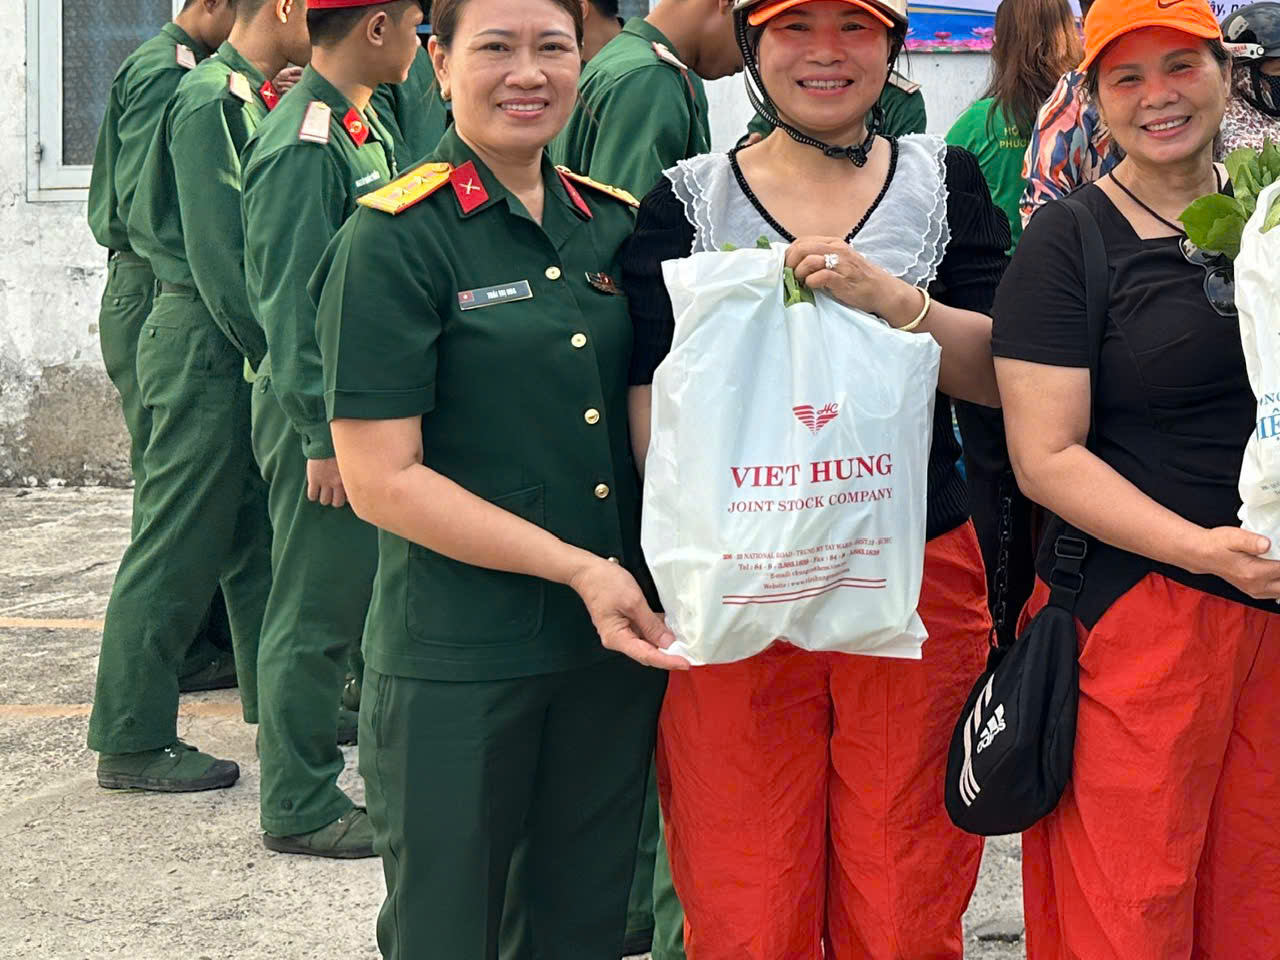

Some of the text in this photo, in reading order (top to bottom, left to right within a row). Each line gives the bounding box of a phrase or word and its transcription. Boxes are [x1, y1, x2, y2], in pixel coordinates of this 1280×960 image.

[730, 453, 893, 489] VIET HUNG
[727, 487, 893, 513] JOINT STOCK COMPANY
[744, 551, 775, 560] NATIONAL
